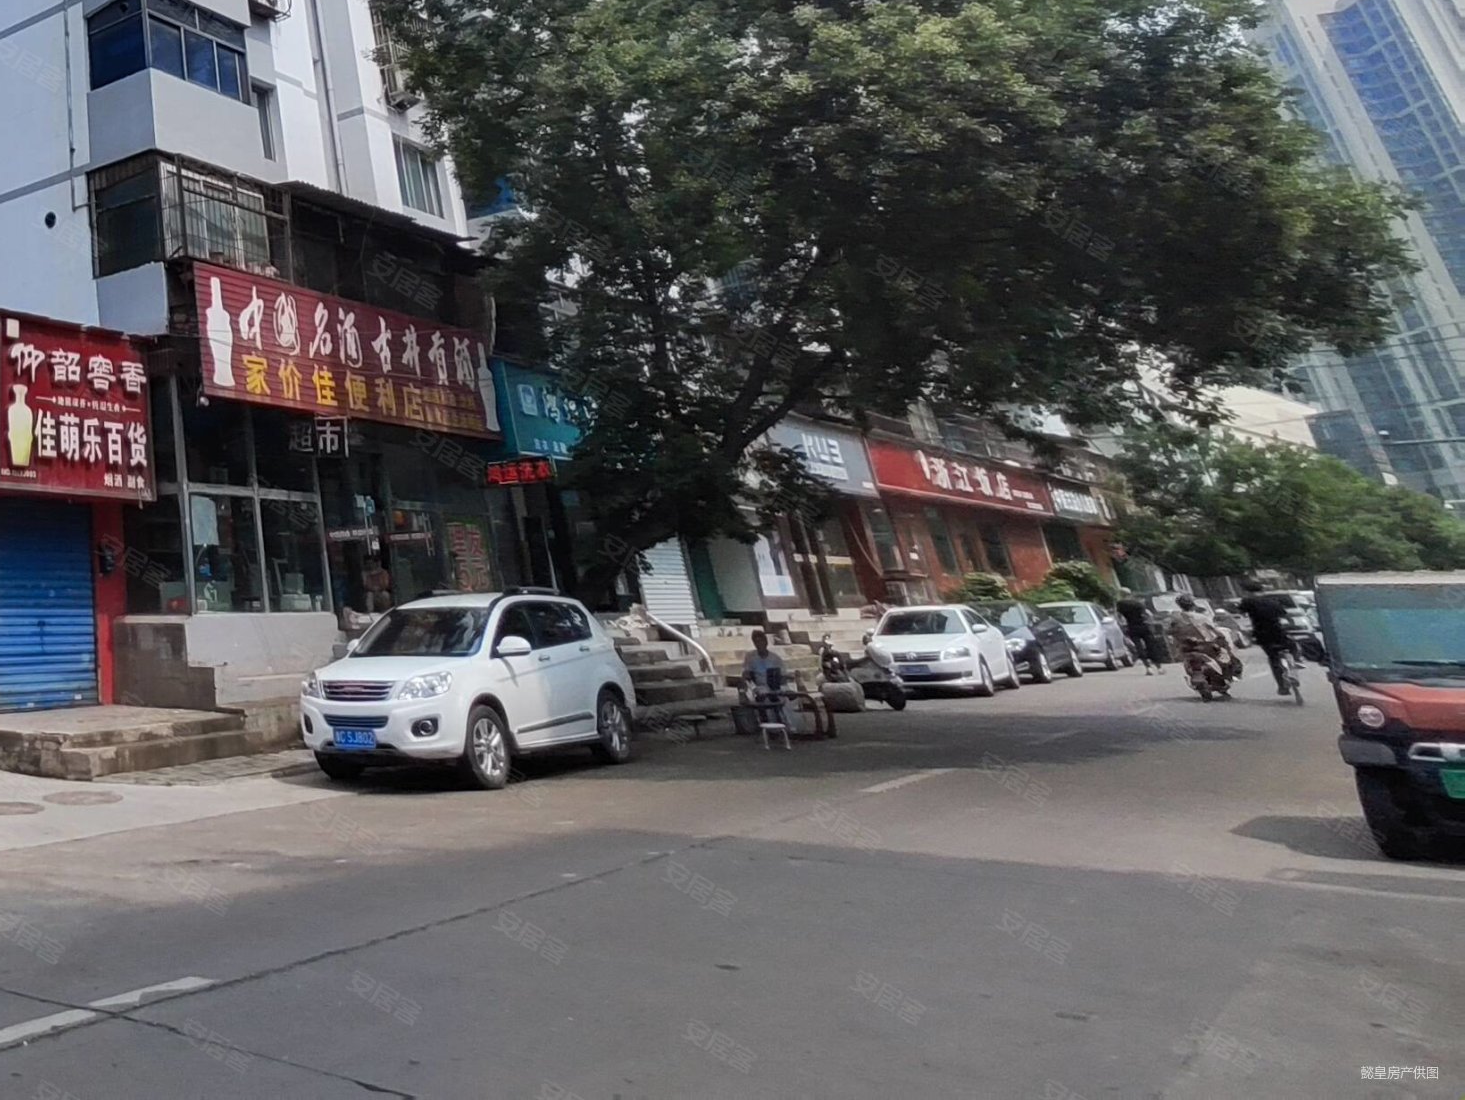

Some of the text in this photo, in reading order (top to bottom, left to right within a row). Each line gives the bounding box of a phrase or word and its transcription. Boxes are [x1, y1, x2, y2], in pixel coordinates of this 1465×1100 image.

[10, 342, 148, 395] 仰韶窖香
[242, 351, 425, 422] 家价佳便利店
[35, 408, 148, 468] 佳萌乐百货
[288, 421, 342, 456] 超市
